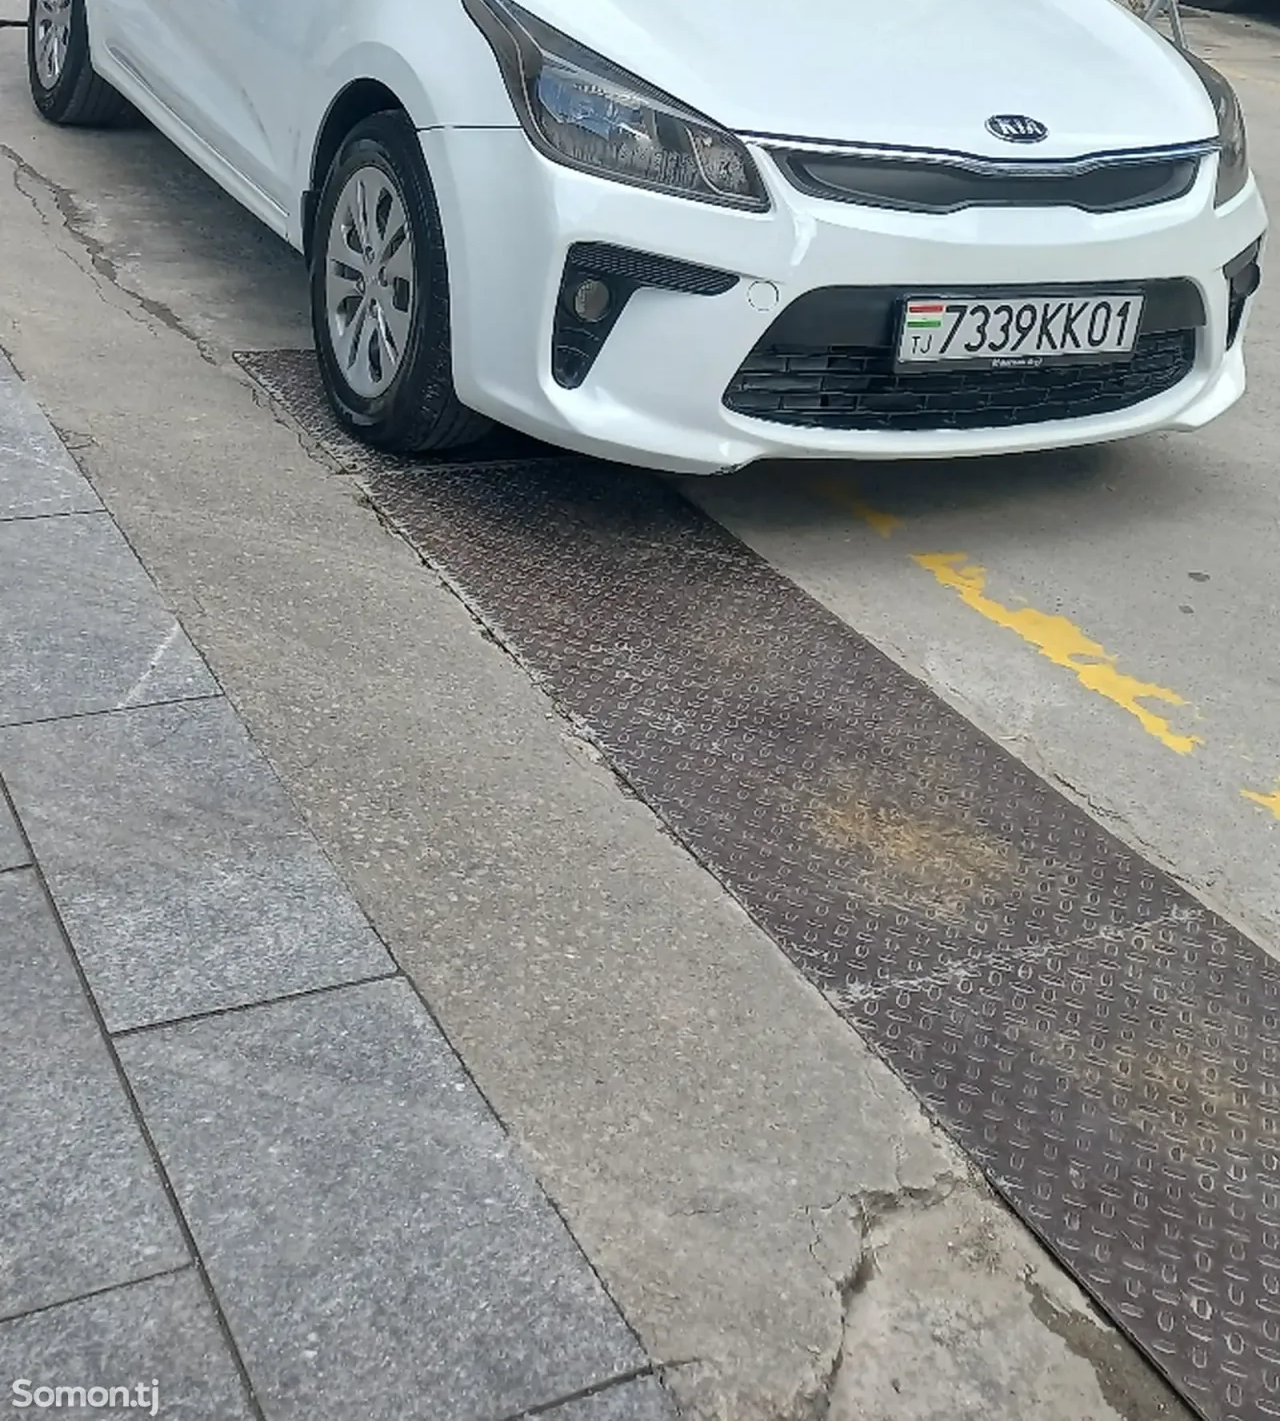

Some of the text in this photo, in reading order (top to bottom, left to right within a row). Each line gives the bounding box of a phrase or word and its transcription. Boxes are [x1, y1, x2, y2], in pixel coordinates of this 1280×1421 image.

[994, 118, 1043, 135] KIA
[911, 301, 1132, 355] TJ 7339KK01
